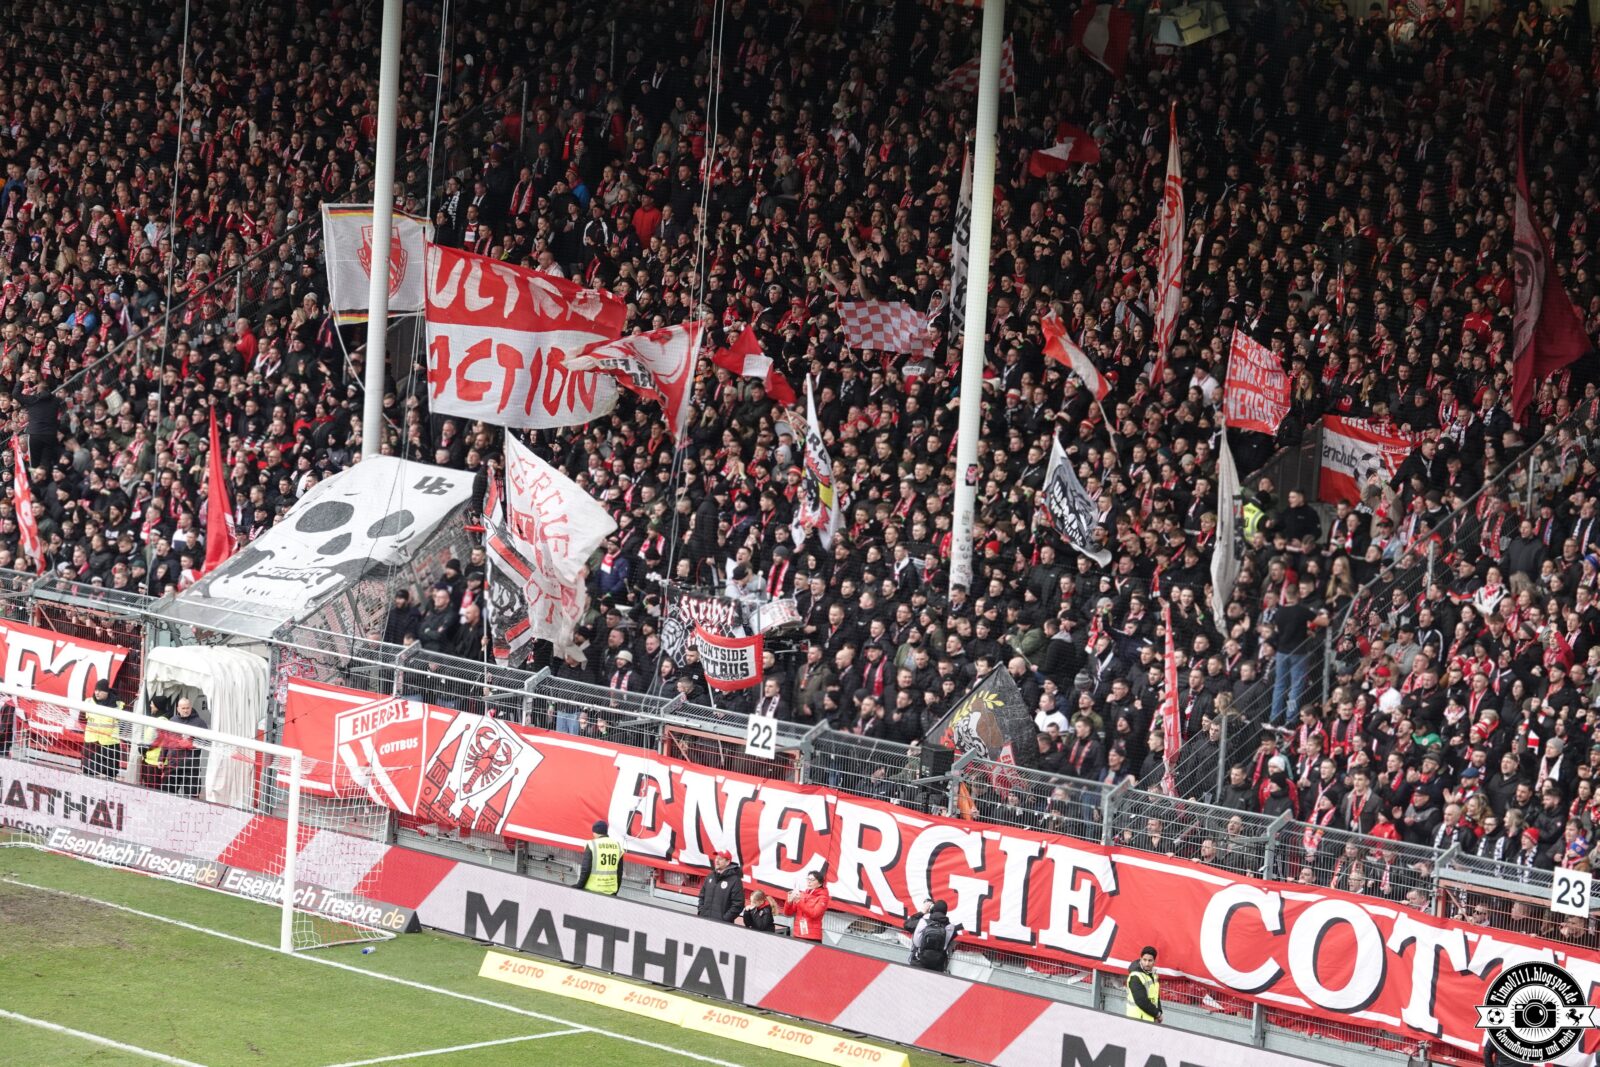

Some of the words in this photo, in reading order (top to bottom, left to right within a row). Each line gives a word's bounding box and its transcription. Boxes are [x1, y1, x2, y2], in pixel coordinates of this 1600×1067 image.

[426, 246, 603, 322] ULTRA
[1226, 386, 1275, 426] NERGIE
[352, 700, 410, 737] ENERGIE
[379, 737, 418, 755] COTTBUS
[750, 722, 772, 750] 22
[0, 776, 124, 832] ATTHÄI
[48, 827, 135, 866] Eisenbach
[134, 846, 218, 885] Tresore.de
[600, 853, 617, 866] 316
[608, 752, 1117, 959] ENERGIE
[223, 867, 318, 907] Eisenbch
[315, 889, 405, 929] Tresore.de
[1556, 876, 1586, 908] 23
[464, 890, 747, 1001] MATTHÄI
[512, 963, 544, 979] LOTTO
[574, 978, 606, 995] LOTTO
[637, 993, 668, 1010] LOTTO
[716, 1012, 749, 1029] LOTTO
[780, 1028, 813, 1045] LOTTO
[847, 1044, 881, 1062] LOTTO
